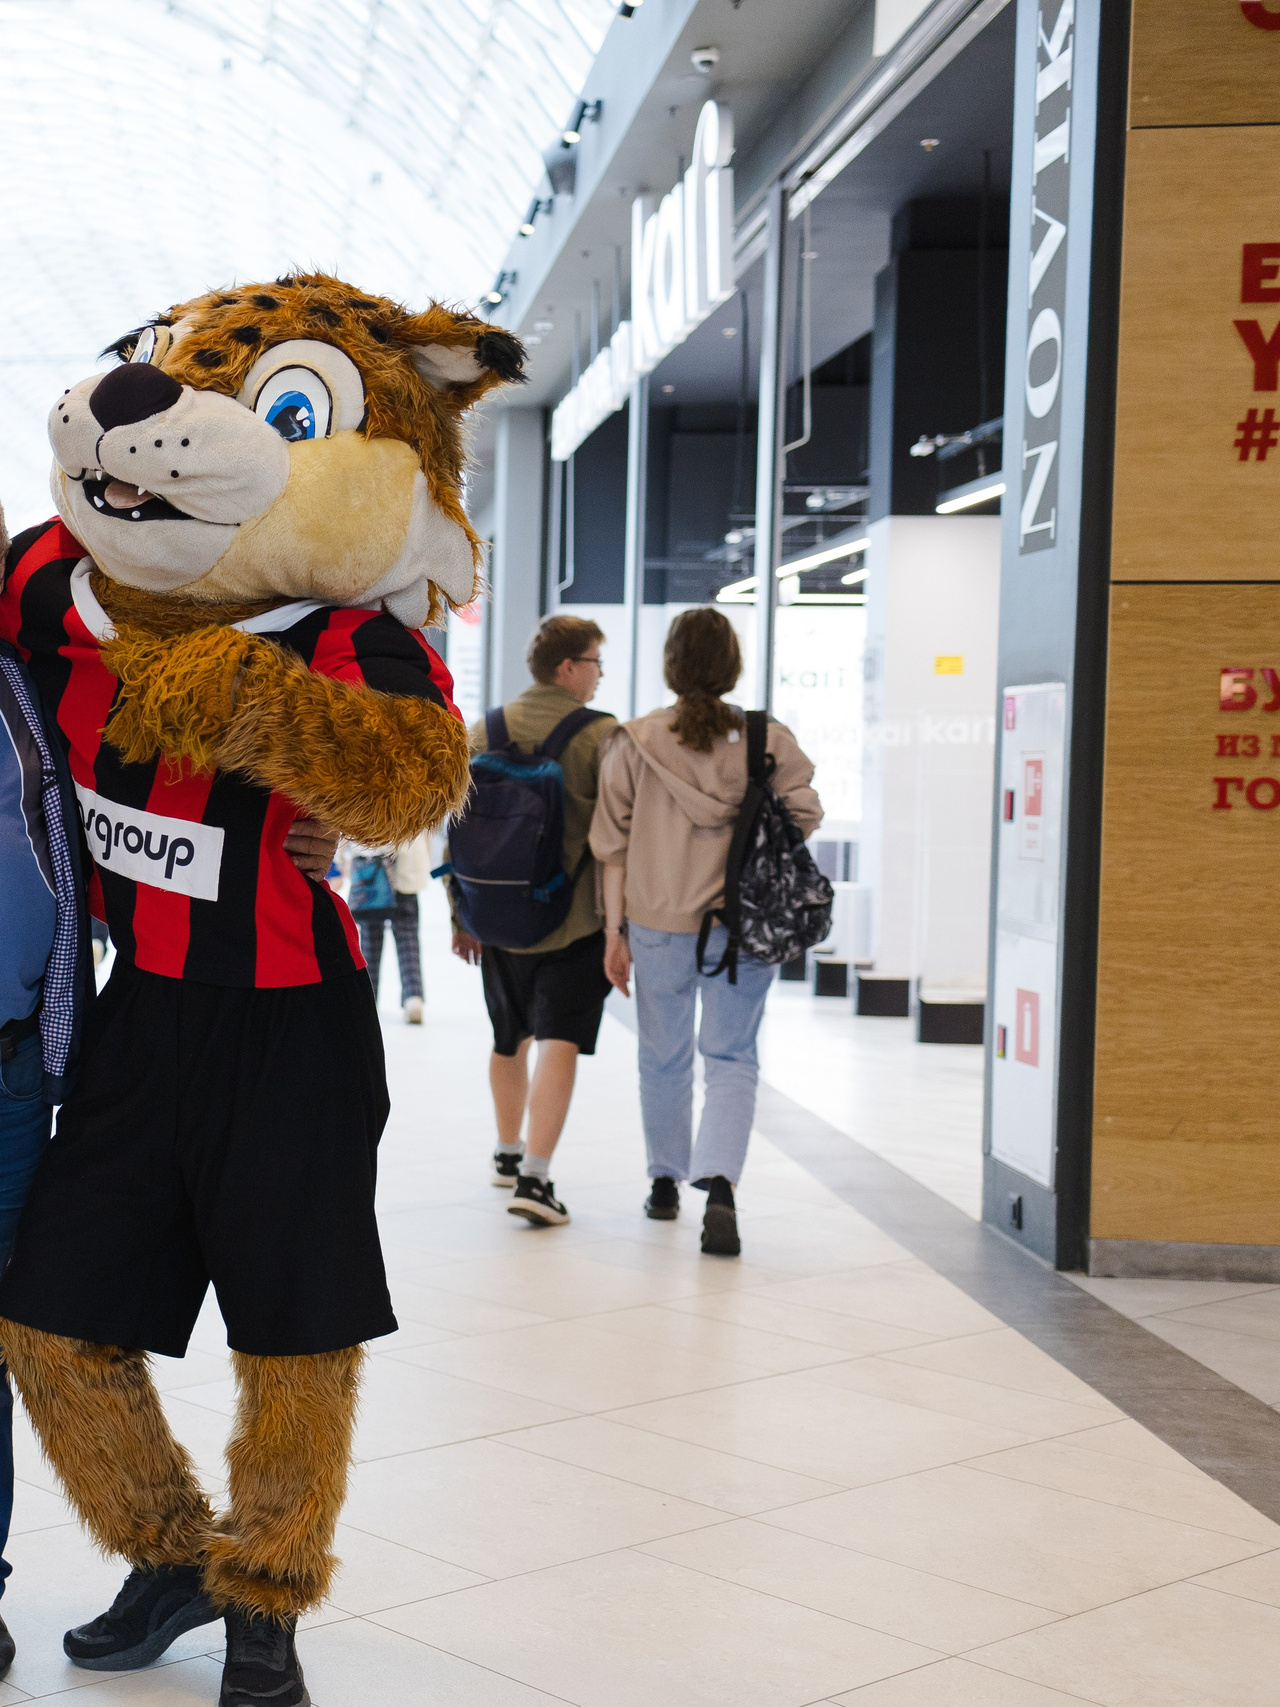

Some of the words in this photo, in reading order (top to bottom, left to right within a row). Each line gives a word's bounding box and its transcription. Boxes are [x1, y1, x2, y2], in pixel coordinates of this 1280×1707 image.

[631, 99, 726, 374] kari
[1020, 0, 1076, 548] NOVIK
[779, 666, 845, 688] kari
[1215, 734, 1261, 758] ИЗ
